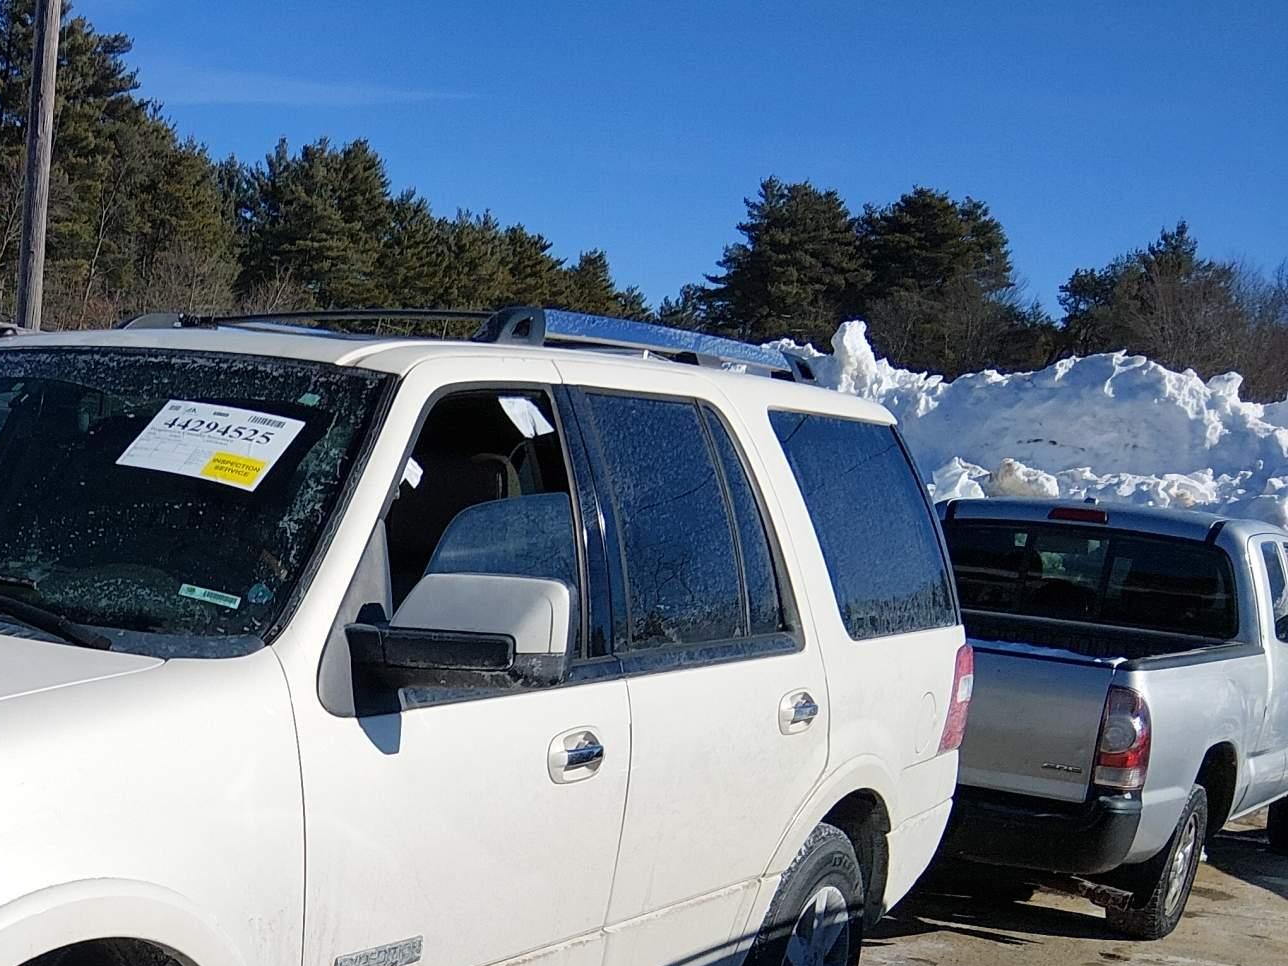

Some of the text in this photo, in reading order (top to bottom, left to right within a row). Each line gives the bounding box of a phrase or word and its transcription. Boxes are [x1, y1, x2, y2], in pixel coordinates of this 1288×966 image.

[164, 416, 274, 444] 44294525
[212, 457, 261, 473] INSPECTION
[214, 464, 250, 478] SERVICE
